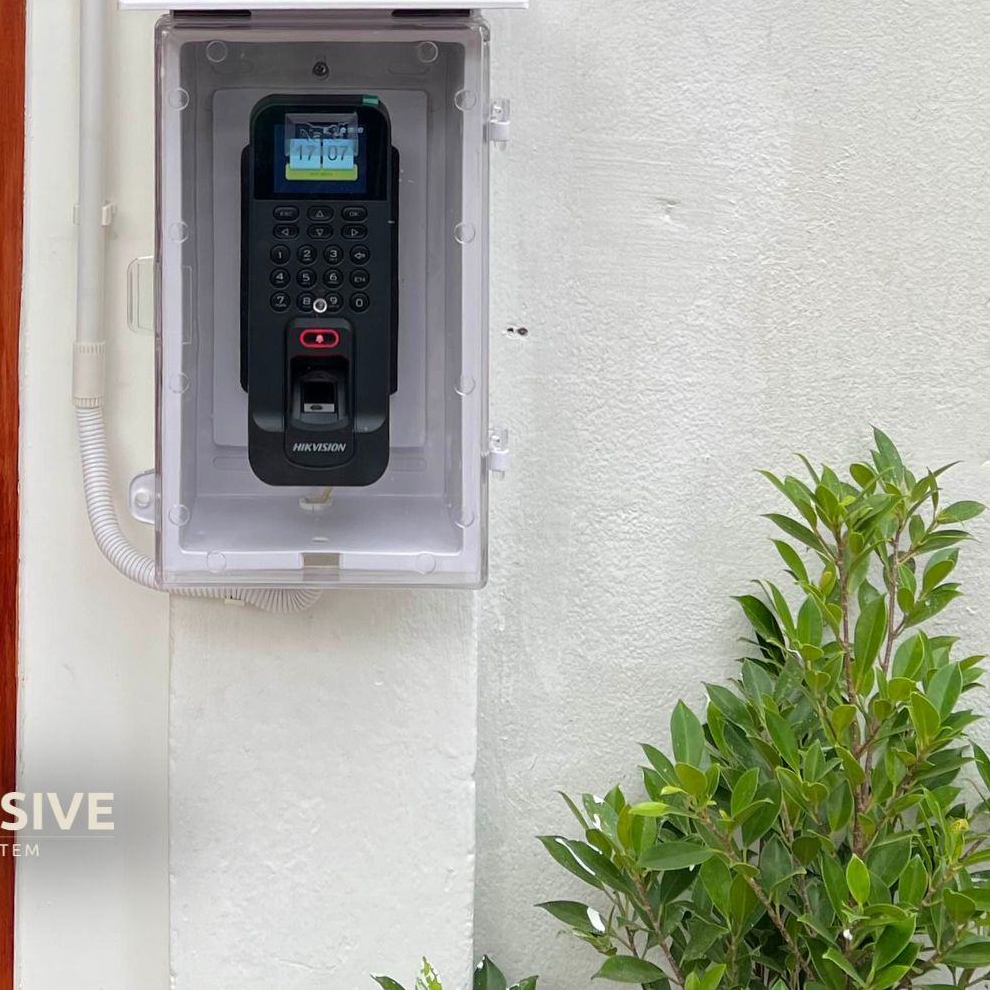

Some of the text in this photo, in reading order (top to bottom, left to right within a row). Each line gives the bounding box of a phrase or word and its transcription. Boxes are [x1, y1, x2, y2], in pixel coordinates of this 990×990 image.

[297, 145, 349, 161] 17 07
[303, 249, 311, 258] 2
[329, 249, 337, 258] 3
[275, 272, 284, 280] 4
[302, 273, 310, 281] 5
[329, 272, 337, 281] 6
[276, 296, 363, 307] 7 8 9 0
[293, 442, 347, 452] HIKVISION
